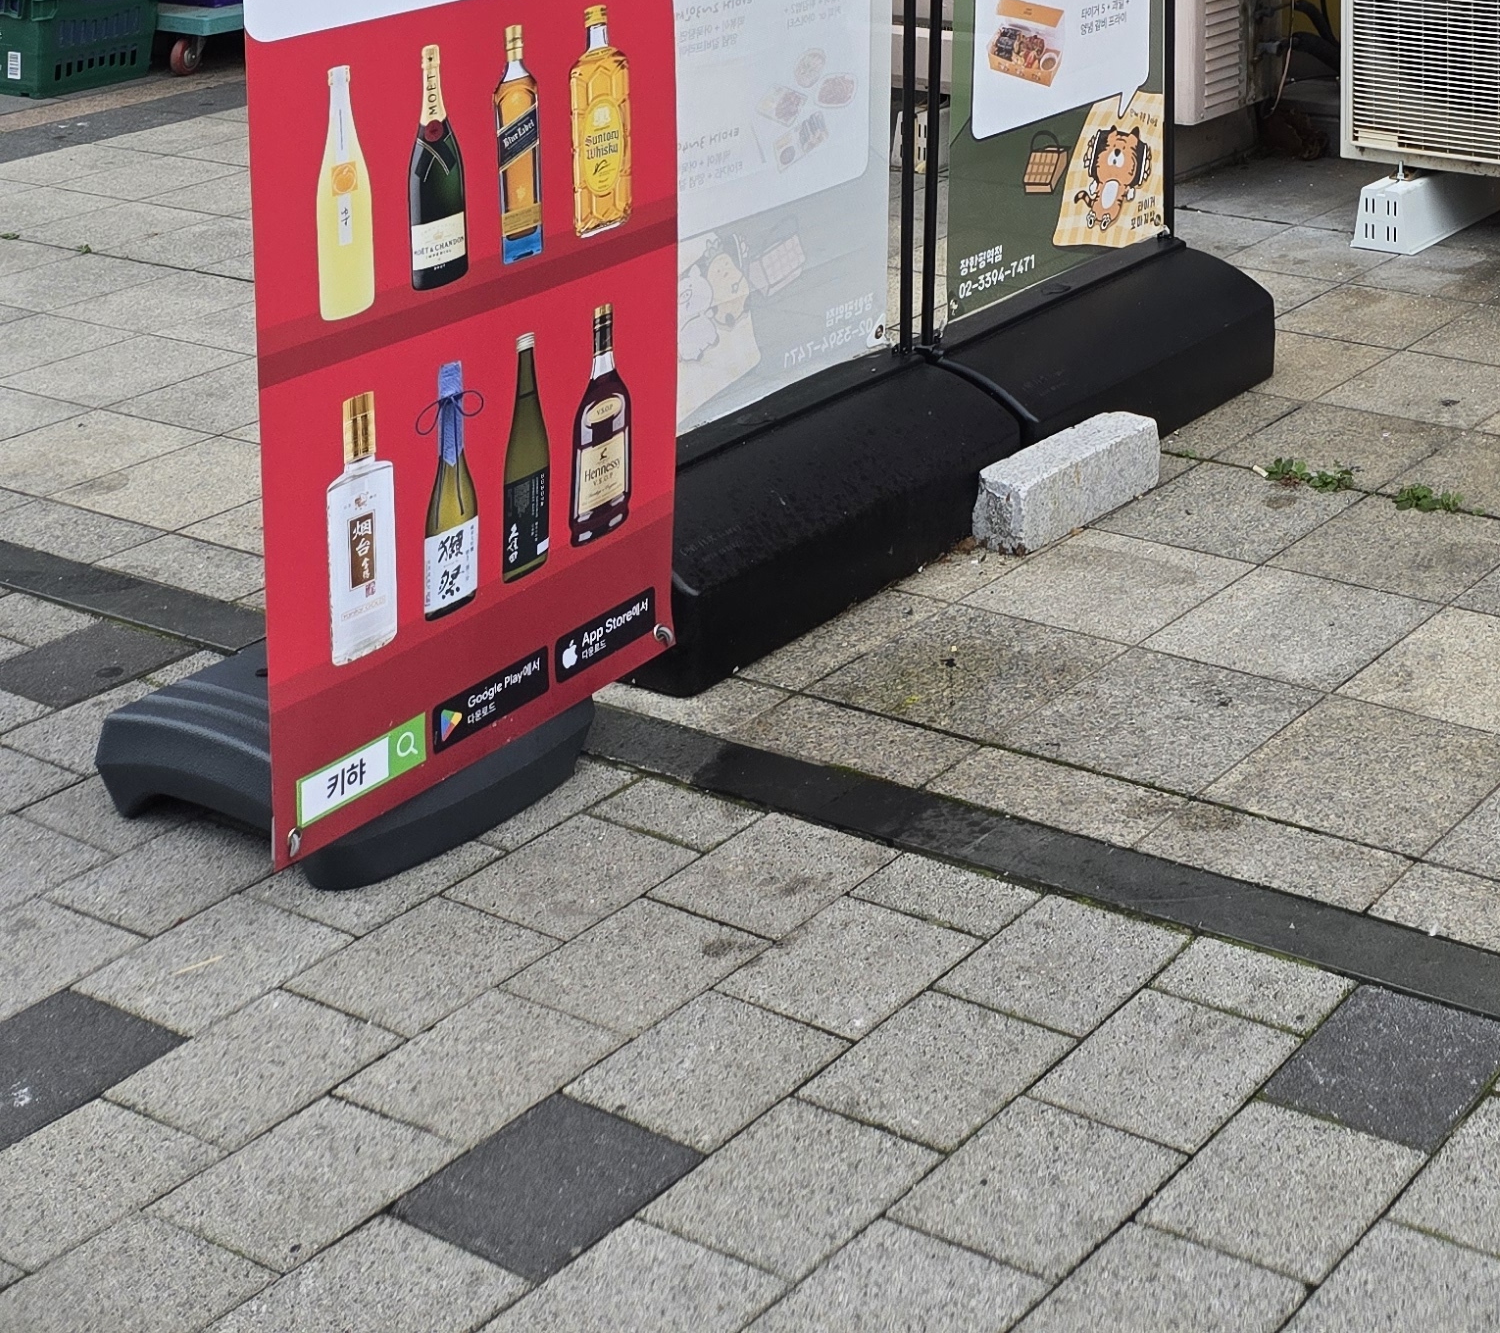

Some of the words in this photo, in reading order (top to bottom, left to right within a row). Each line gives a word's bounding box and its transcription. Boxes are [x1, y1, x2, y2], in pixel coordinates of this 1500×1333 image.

[502, 131, 519, 149] Blue
[518, 120, 535, 138] Label
[584, 129, 619, 147] Suntory
[586, 143, 619, 161] Whisky
[434, 235, 464, 251] CHANDON
[959, 244, 1002, 276] 장한평역점
[958, 254, 1035, 299] 02-3394-7471
[584, 459, 620, 482] Hennessy
[581, 624, 604, 646] App
[606, 599, 648, 633] Store에서
[581, 639, 606, 660] 다운로드
[467, 682, 502, 709] Google
[504, 657, 540, 689] Play에서
[467, 701, 496, 725] 다운로드
[327, 758, 366, 800] 키햐
